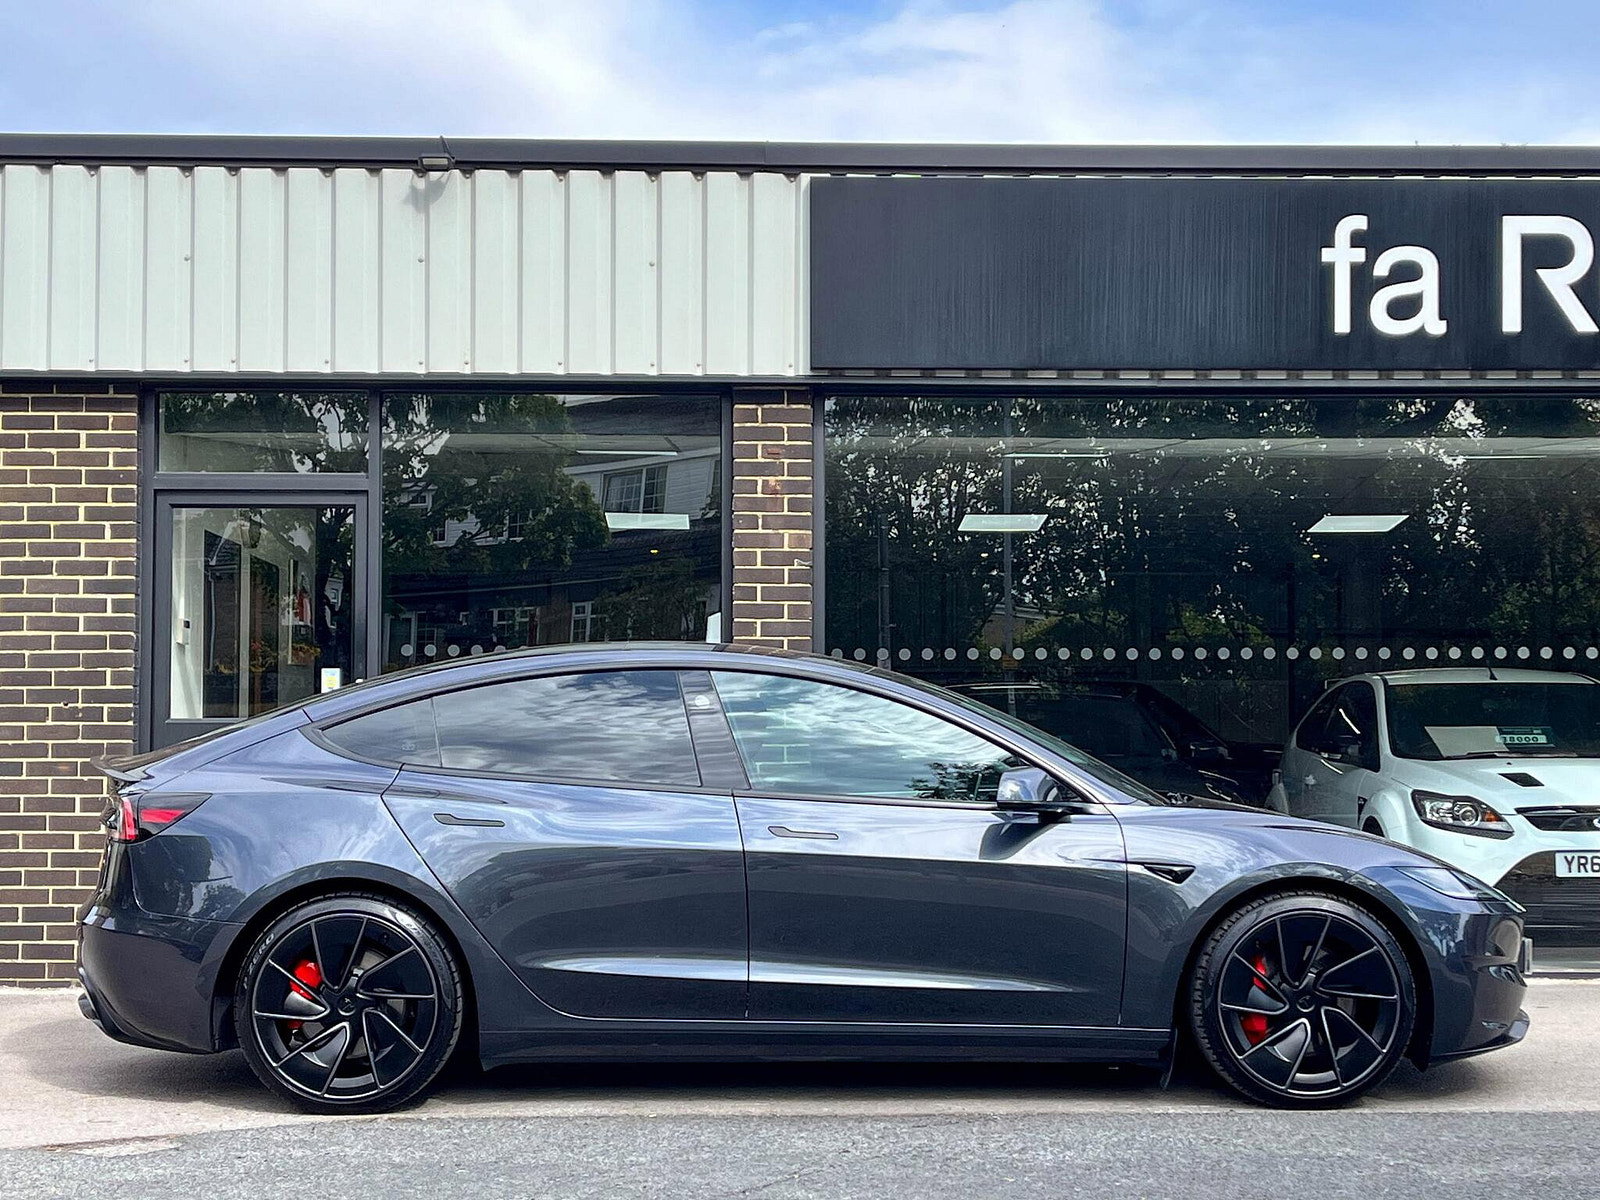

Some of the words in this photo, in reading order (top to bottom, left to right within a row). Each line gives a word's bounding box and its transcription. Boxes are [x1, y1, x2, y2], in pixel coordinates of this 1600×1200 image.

[1321, 214, 1447, 336] fa
[1501, 214, 1600, 334] R
[1563, 855, 1600, 873] YR6
